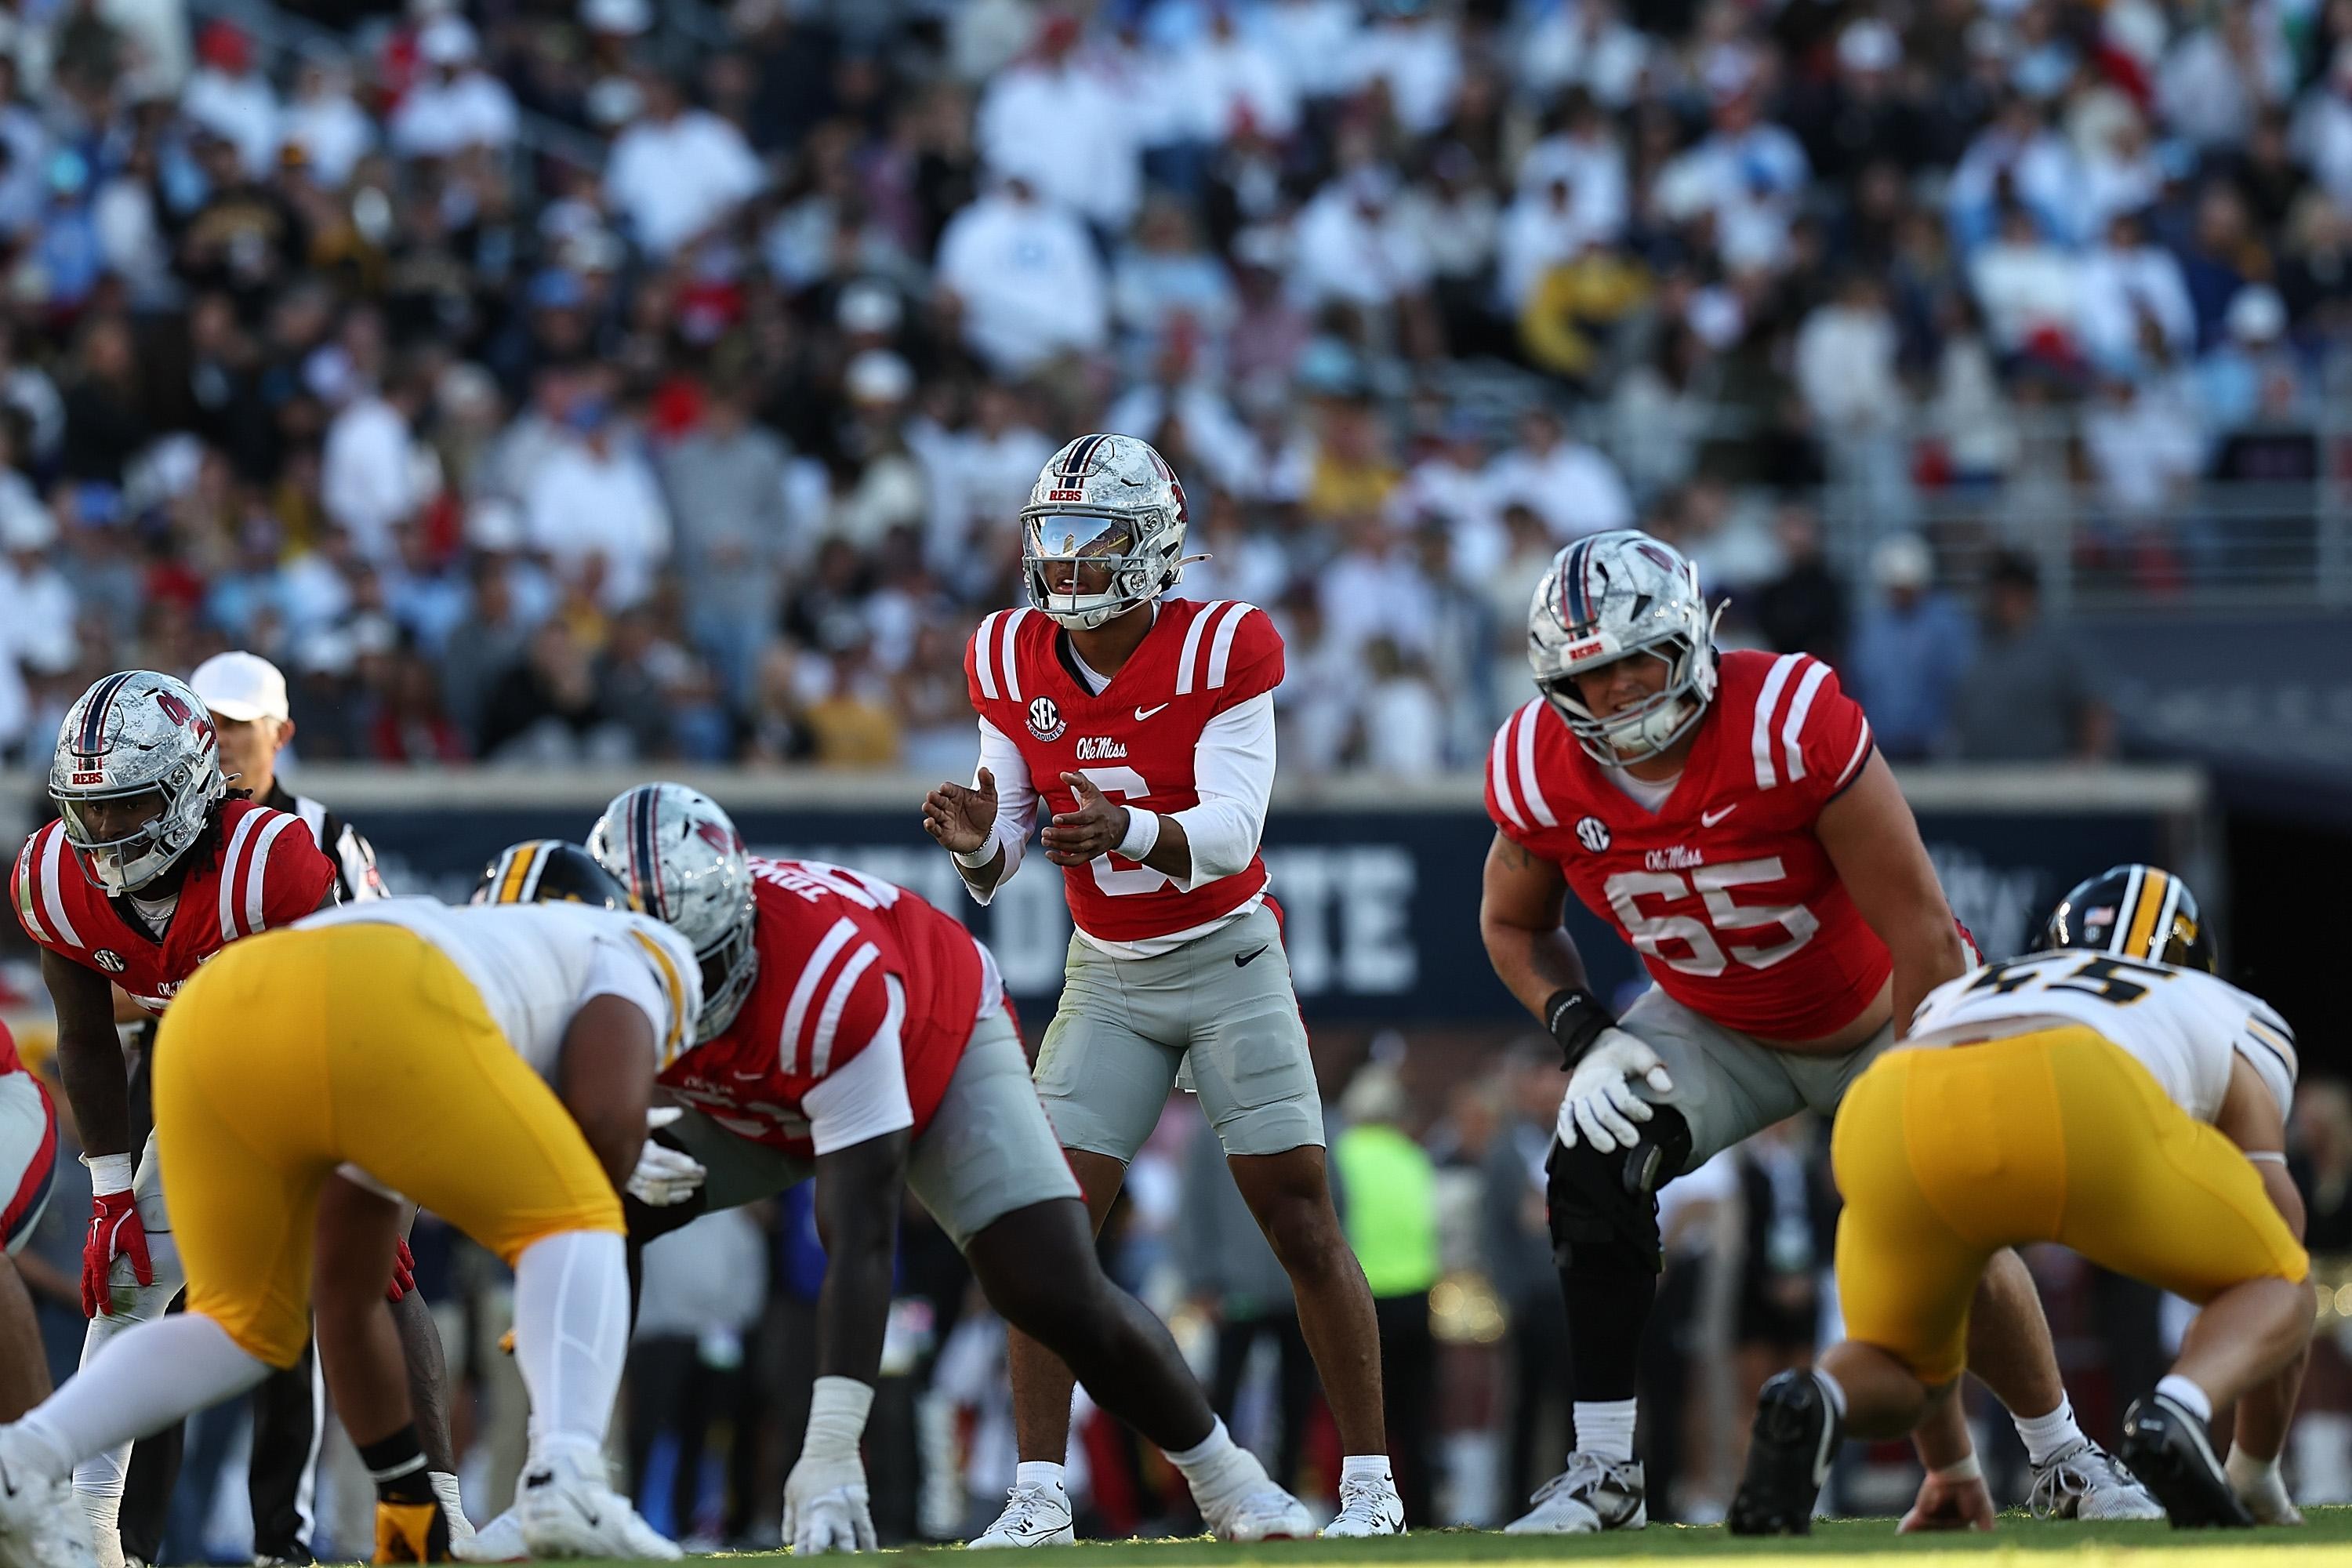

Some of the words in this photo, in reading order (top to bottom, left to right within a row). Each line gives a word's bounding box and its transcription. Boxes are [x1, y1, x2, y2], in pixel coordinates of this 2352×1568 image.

[1049, 490, 1083, 502] REBS
[1029, 697, 1058, 730] SEC
[1029, 726, 1062, 741] GRADUATE
[72, 771, 103, 785] REBS
[1603, 856, 1820, 977] 65
[94, 949, 124, 972] SEC
